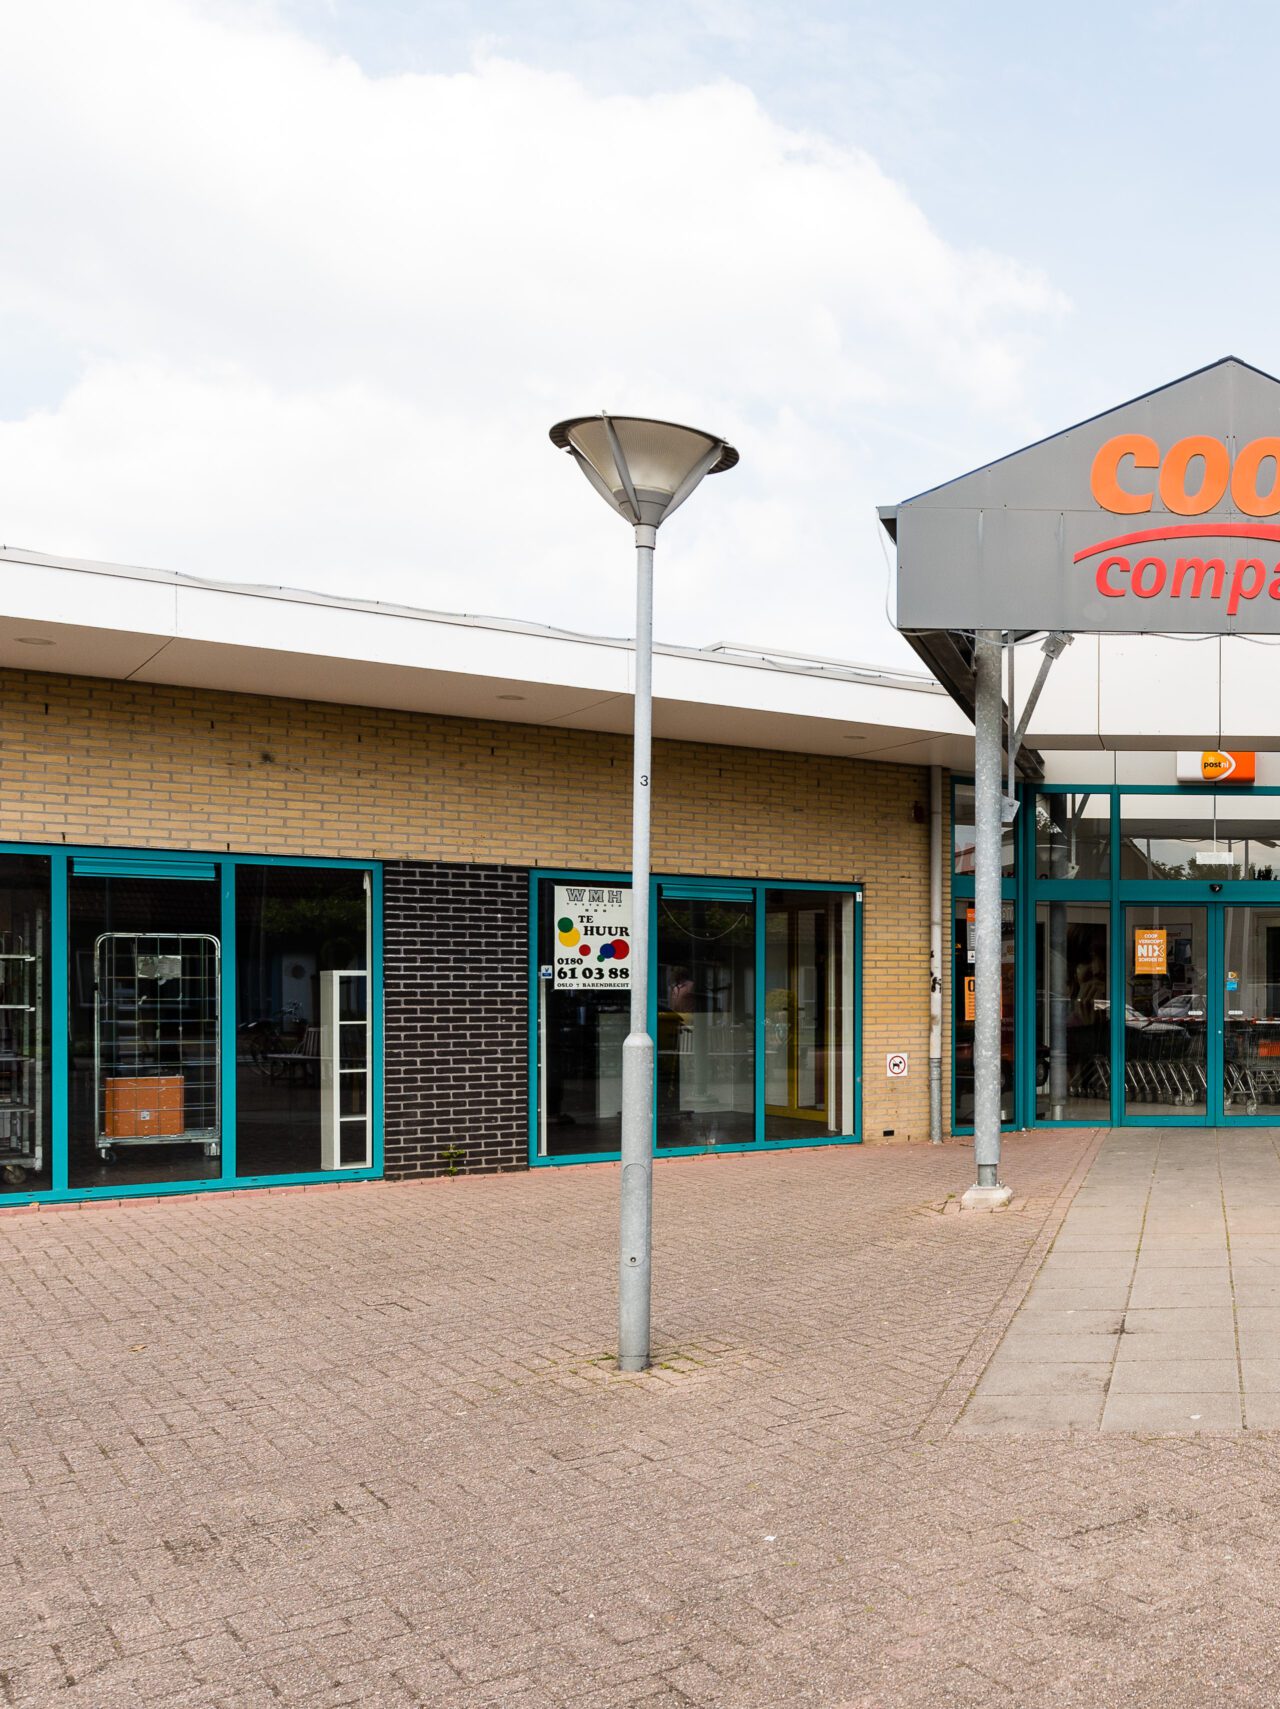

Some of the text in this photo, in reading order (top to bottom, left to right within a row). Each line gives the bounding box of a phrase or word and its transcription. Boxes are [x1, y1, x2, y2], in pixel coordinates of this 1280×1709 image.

[1203, 761, 1229, 769] postnl
[640, 775, 648, 786] 3
[578, 915, 594, 924] TE
[583, 926, 630, 936] HUUR
[1137, 945, 1164, 957] NIX
[557, 957, 583, 966] 0180
[557, 967, 578, 979] 61
[582, 967, 604, 980] 03
[608, 967, 630, 979] 88
